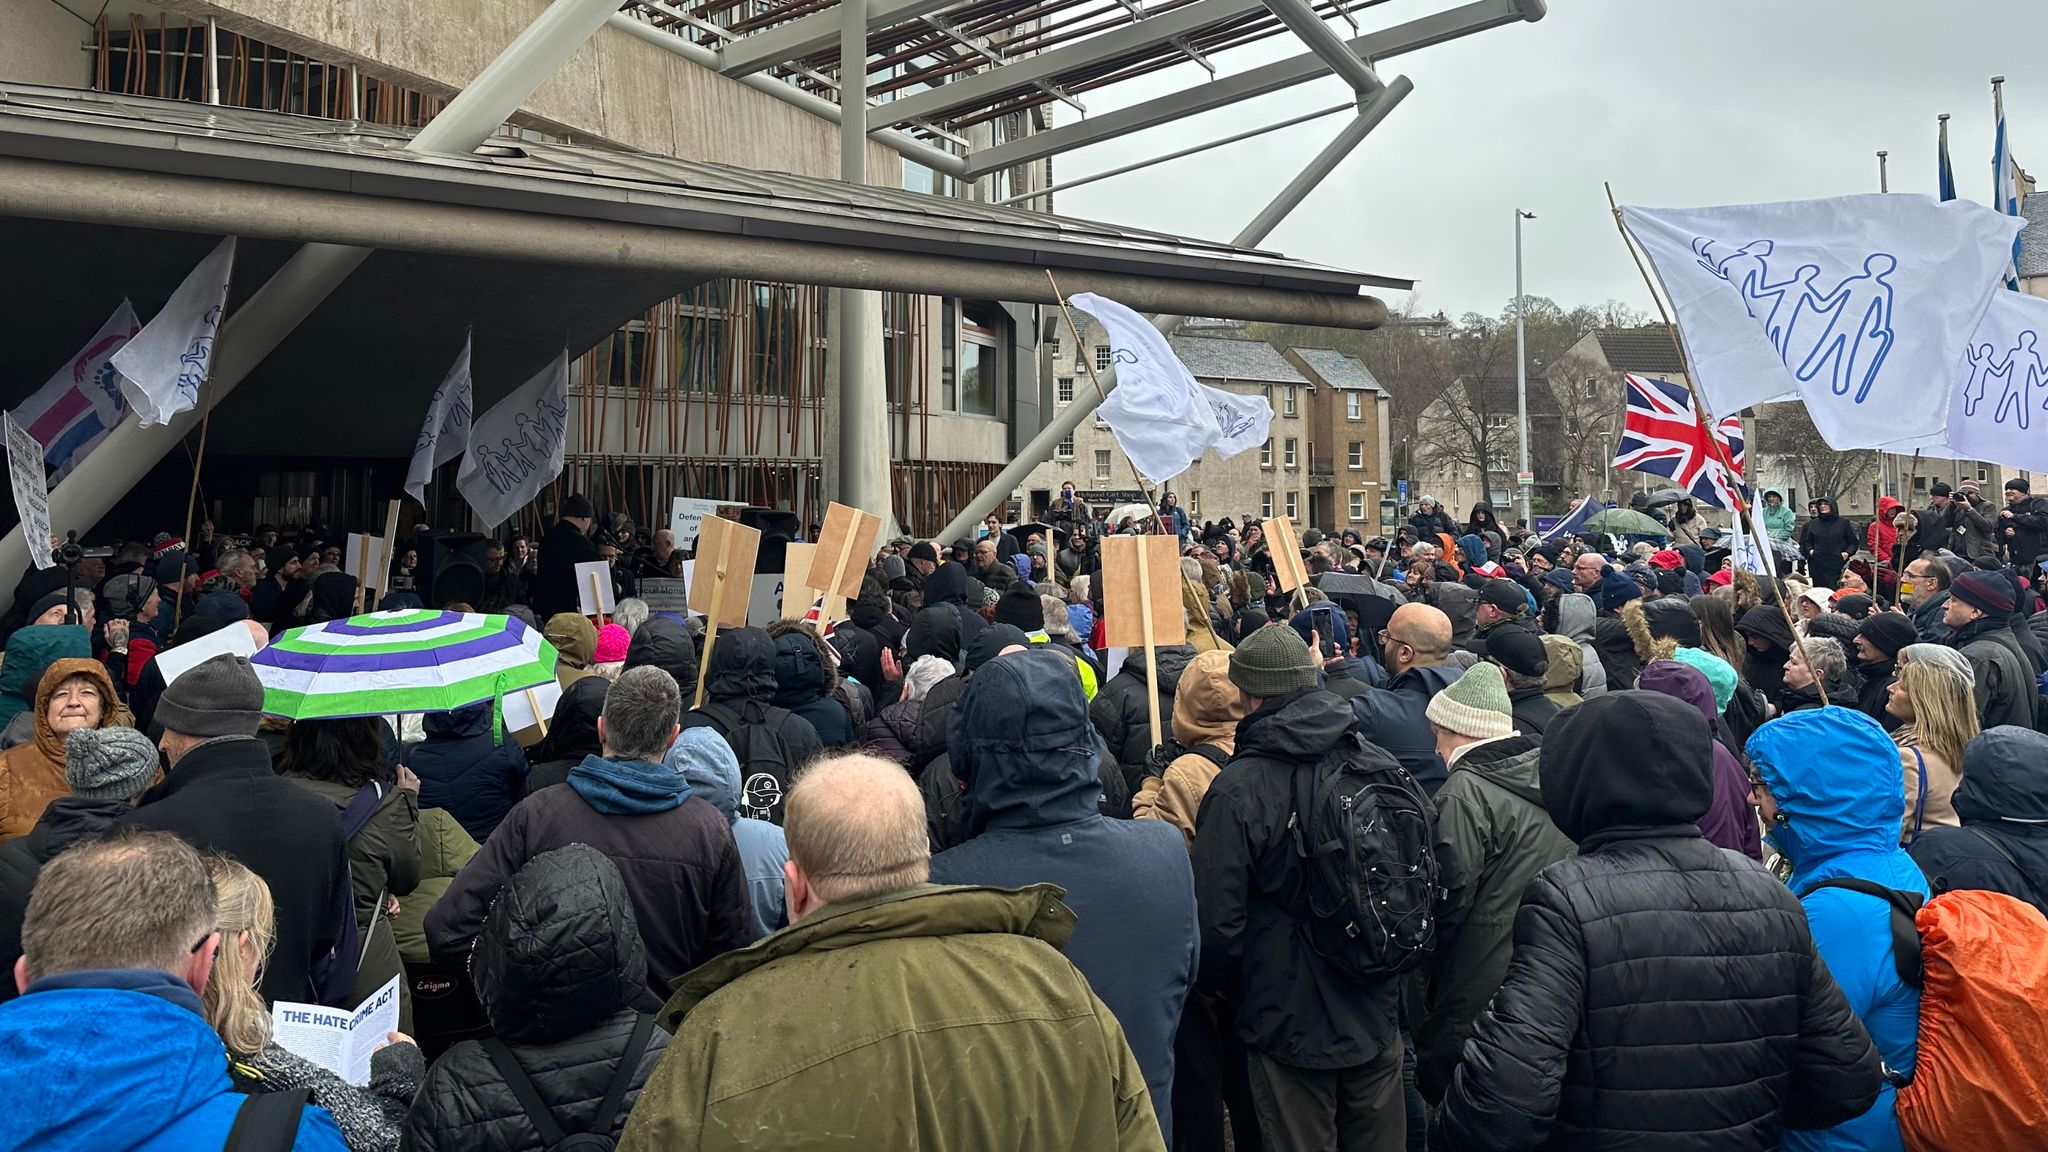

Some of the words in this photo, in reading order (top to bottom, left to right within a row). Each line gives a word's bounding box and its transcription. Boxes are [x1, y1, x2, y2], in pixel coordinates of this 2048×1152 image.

[679, 513, 702, 521] Defen
[417, 981, 451, 992] Enigma
[282, 1010, 311, 1024] THE
[313, 1013, 348, 1030] HATE
[349, 1002, 374, 1031] CRIME
[375, 986, 394, 1010] ACT
